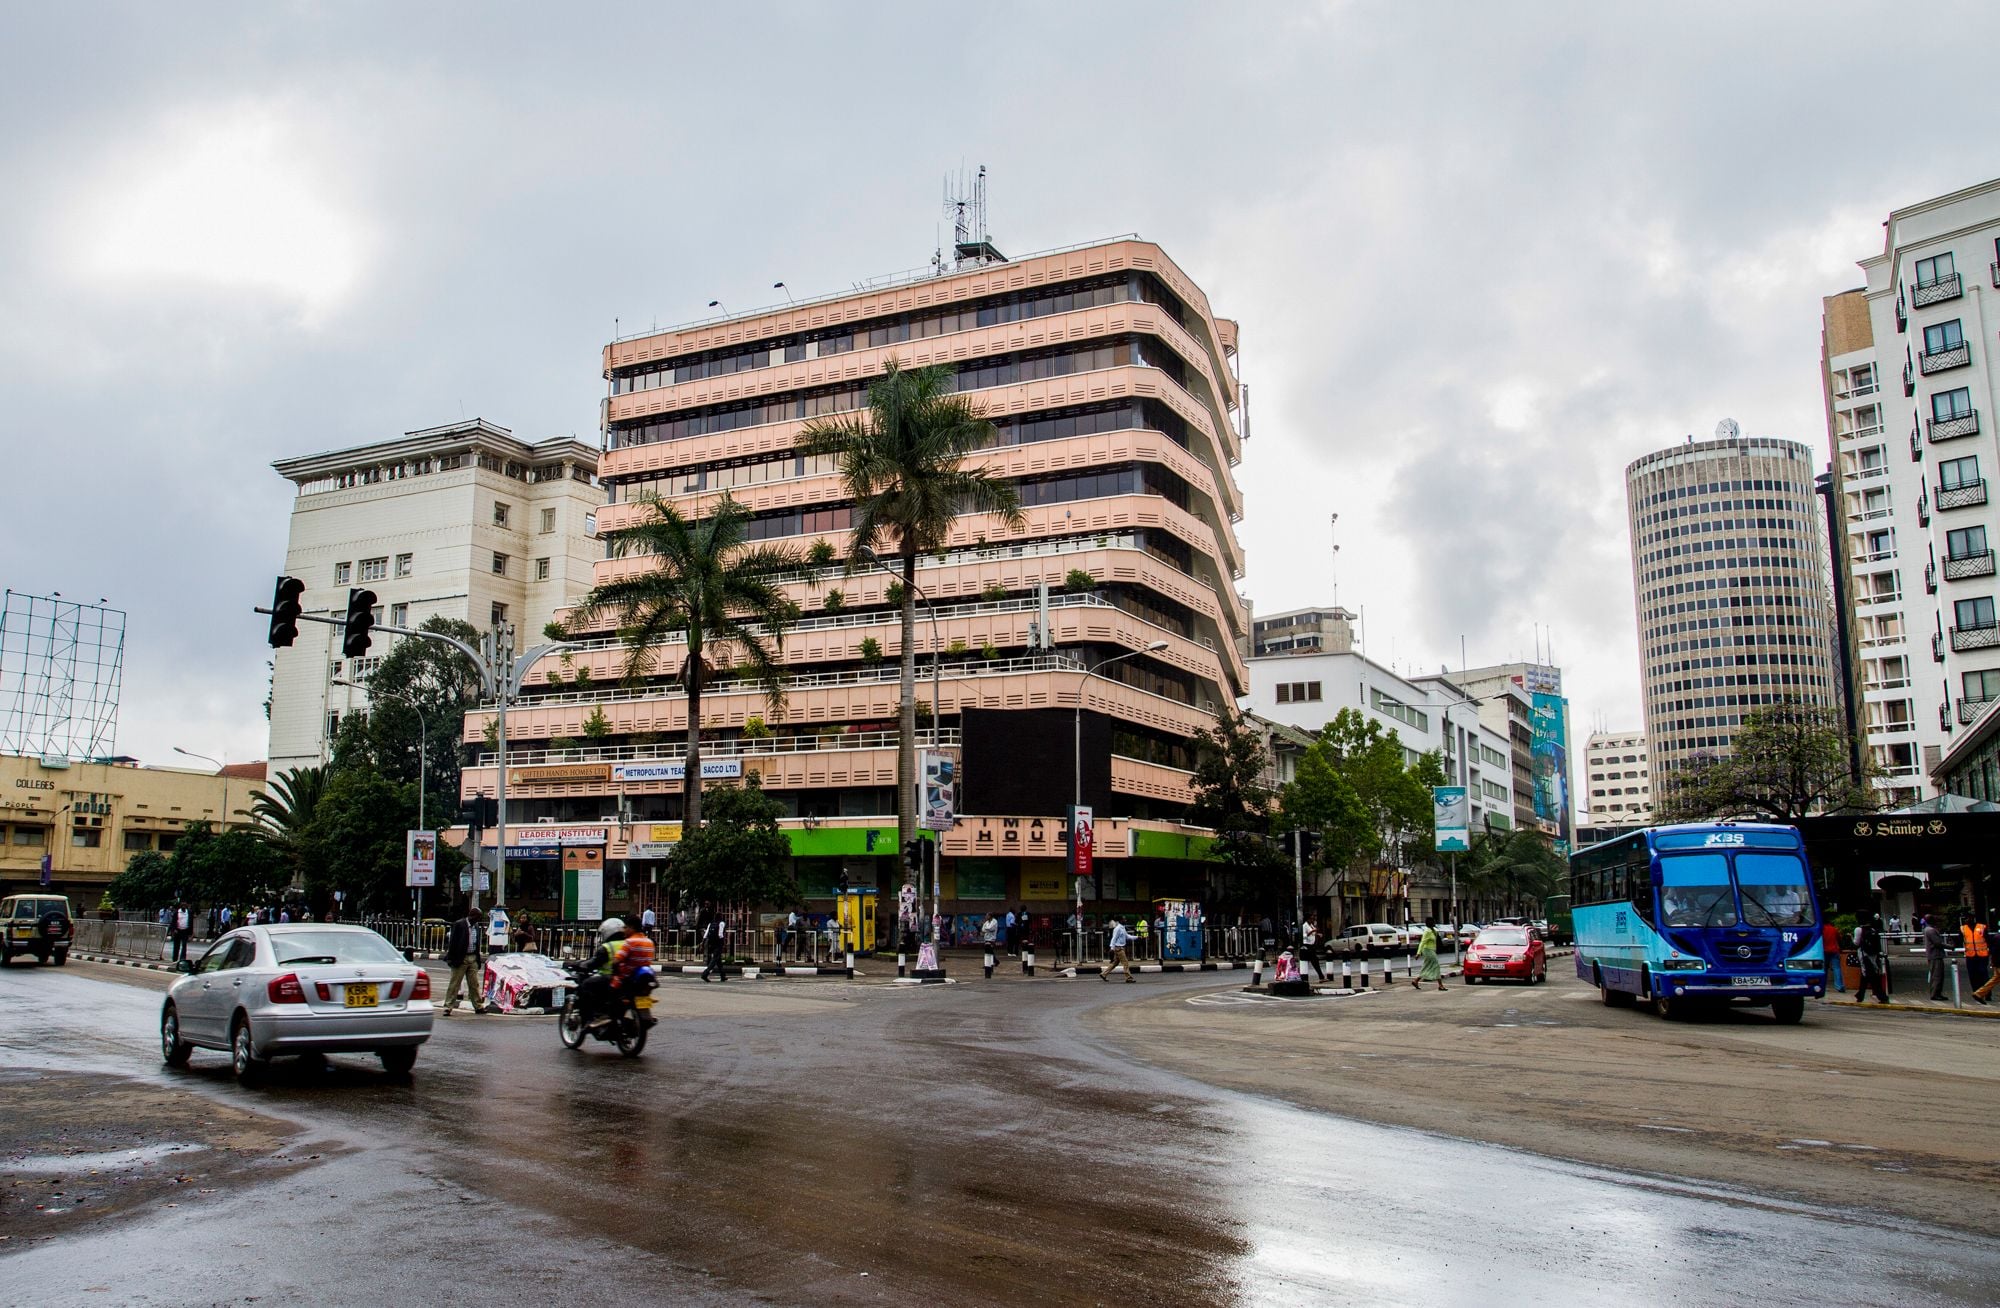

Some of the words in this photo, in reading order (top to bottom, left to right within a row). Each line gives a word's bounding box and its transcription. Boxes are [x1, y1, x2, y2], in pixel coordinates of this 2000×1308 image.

[522, 770, 545, 778] GIFTED
[546, 769, 568, 777] HANDS
[569, 768, 593, 776] HOMES
[594, 767, 606, 775] LTD
[625, 767, 669, 777] METROPOLITAN
[703, 765, 723, 774] SACCO
[725, 764, 739, 773] LTD.
[16, 778, 55, 790] COLLEGES
[75, 802, 112, 815] HOUSE
[953, 818, 1117, 829] KIMATI
[520, 830, 556, 839] LEADERS
[559, 829, 602, 838] INSTITUTE
[1876, 822, 1924, 837] Stanley
[979, 830, 1068, 842] HOUS
[1711, 833, 1745, 843] KBS
[505, 848, 530, 857] BUREAU
[1782, 932, 1798, 943] 874
[347, 985, 369, 996] KBR
